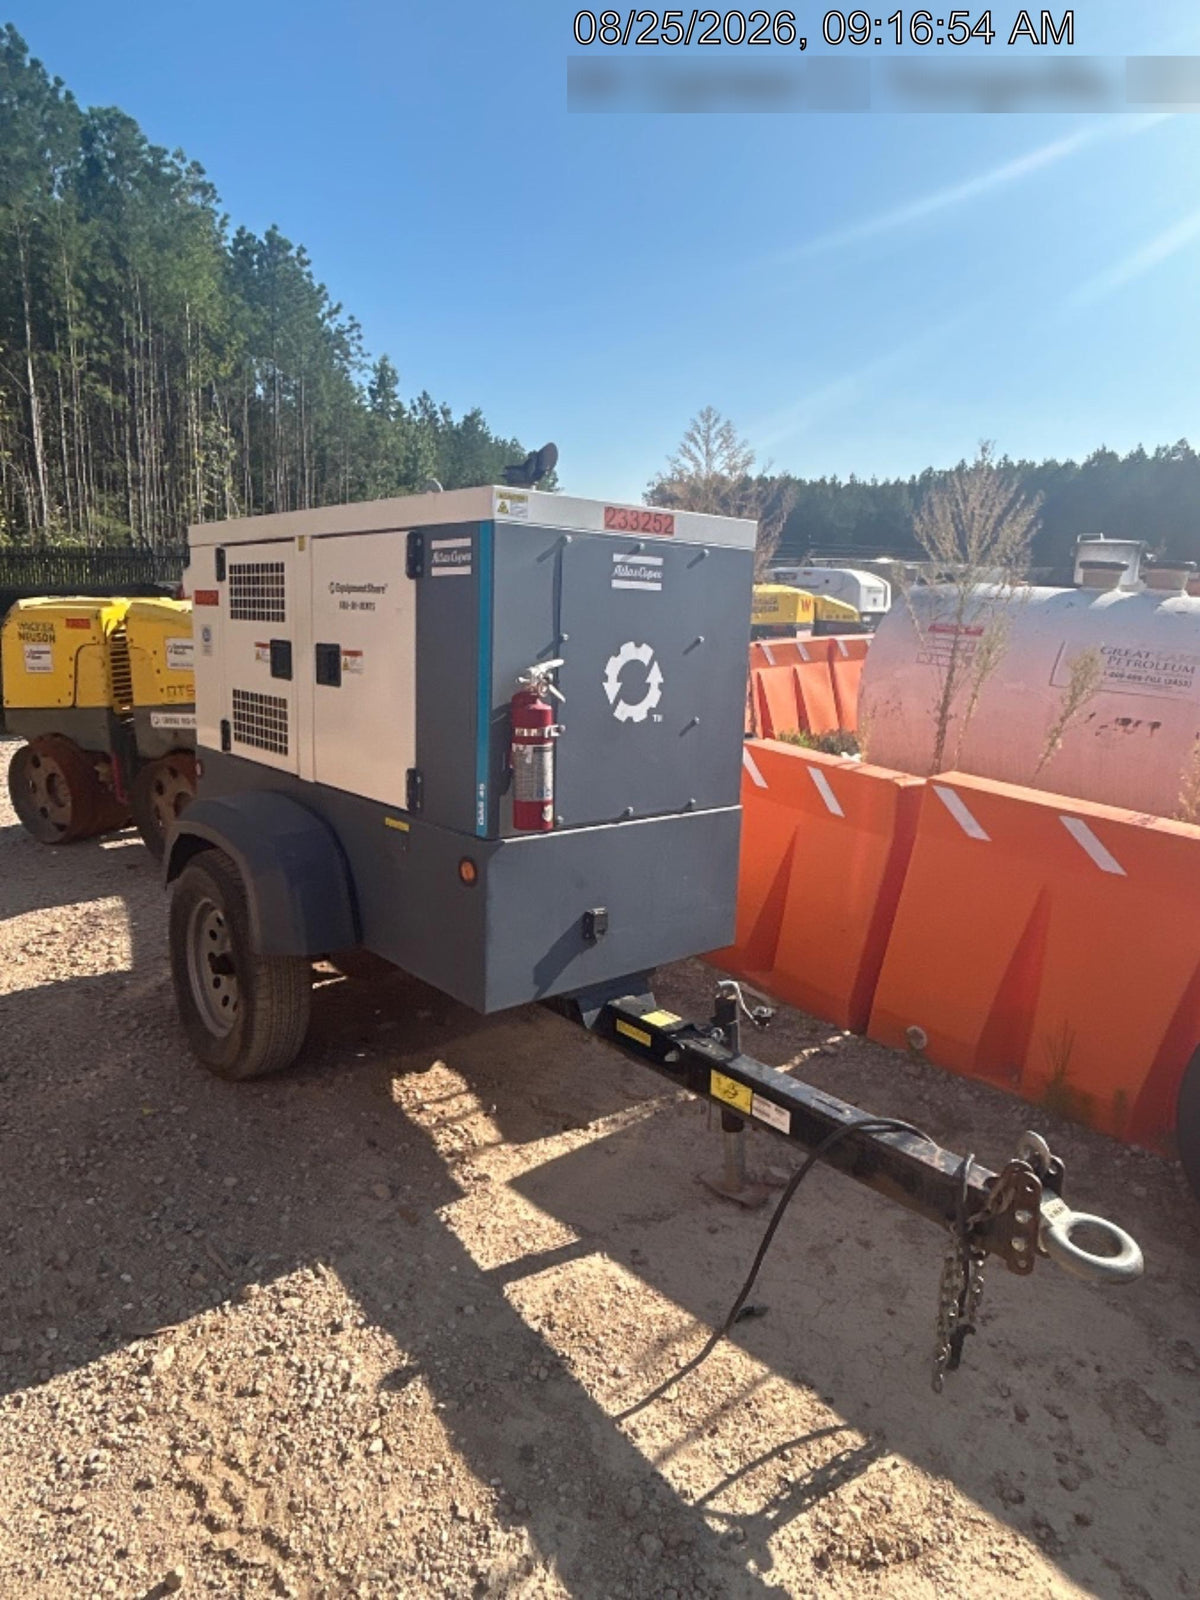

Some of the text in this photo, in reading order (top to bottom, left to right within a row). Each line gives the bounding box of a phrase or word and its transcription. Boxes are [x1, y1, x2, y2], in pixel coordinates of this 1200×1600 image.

[604, 507, 674, 534] 233252
[1100, 646, 1152, 659] GREAT
[1107, 655, 1196, 674] PETROLEUM
